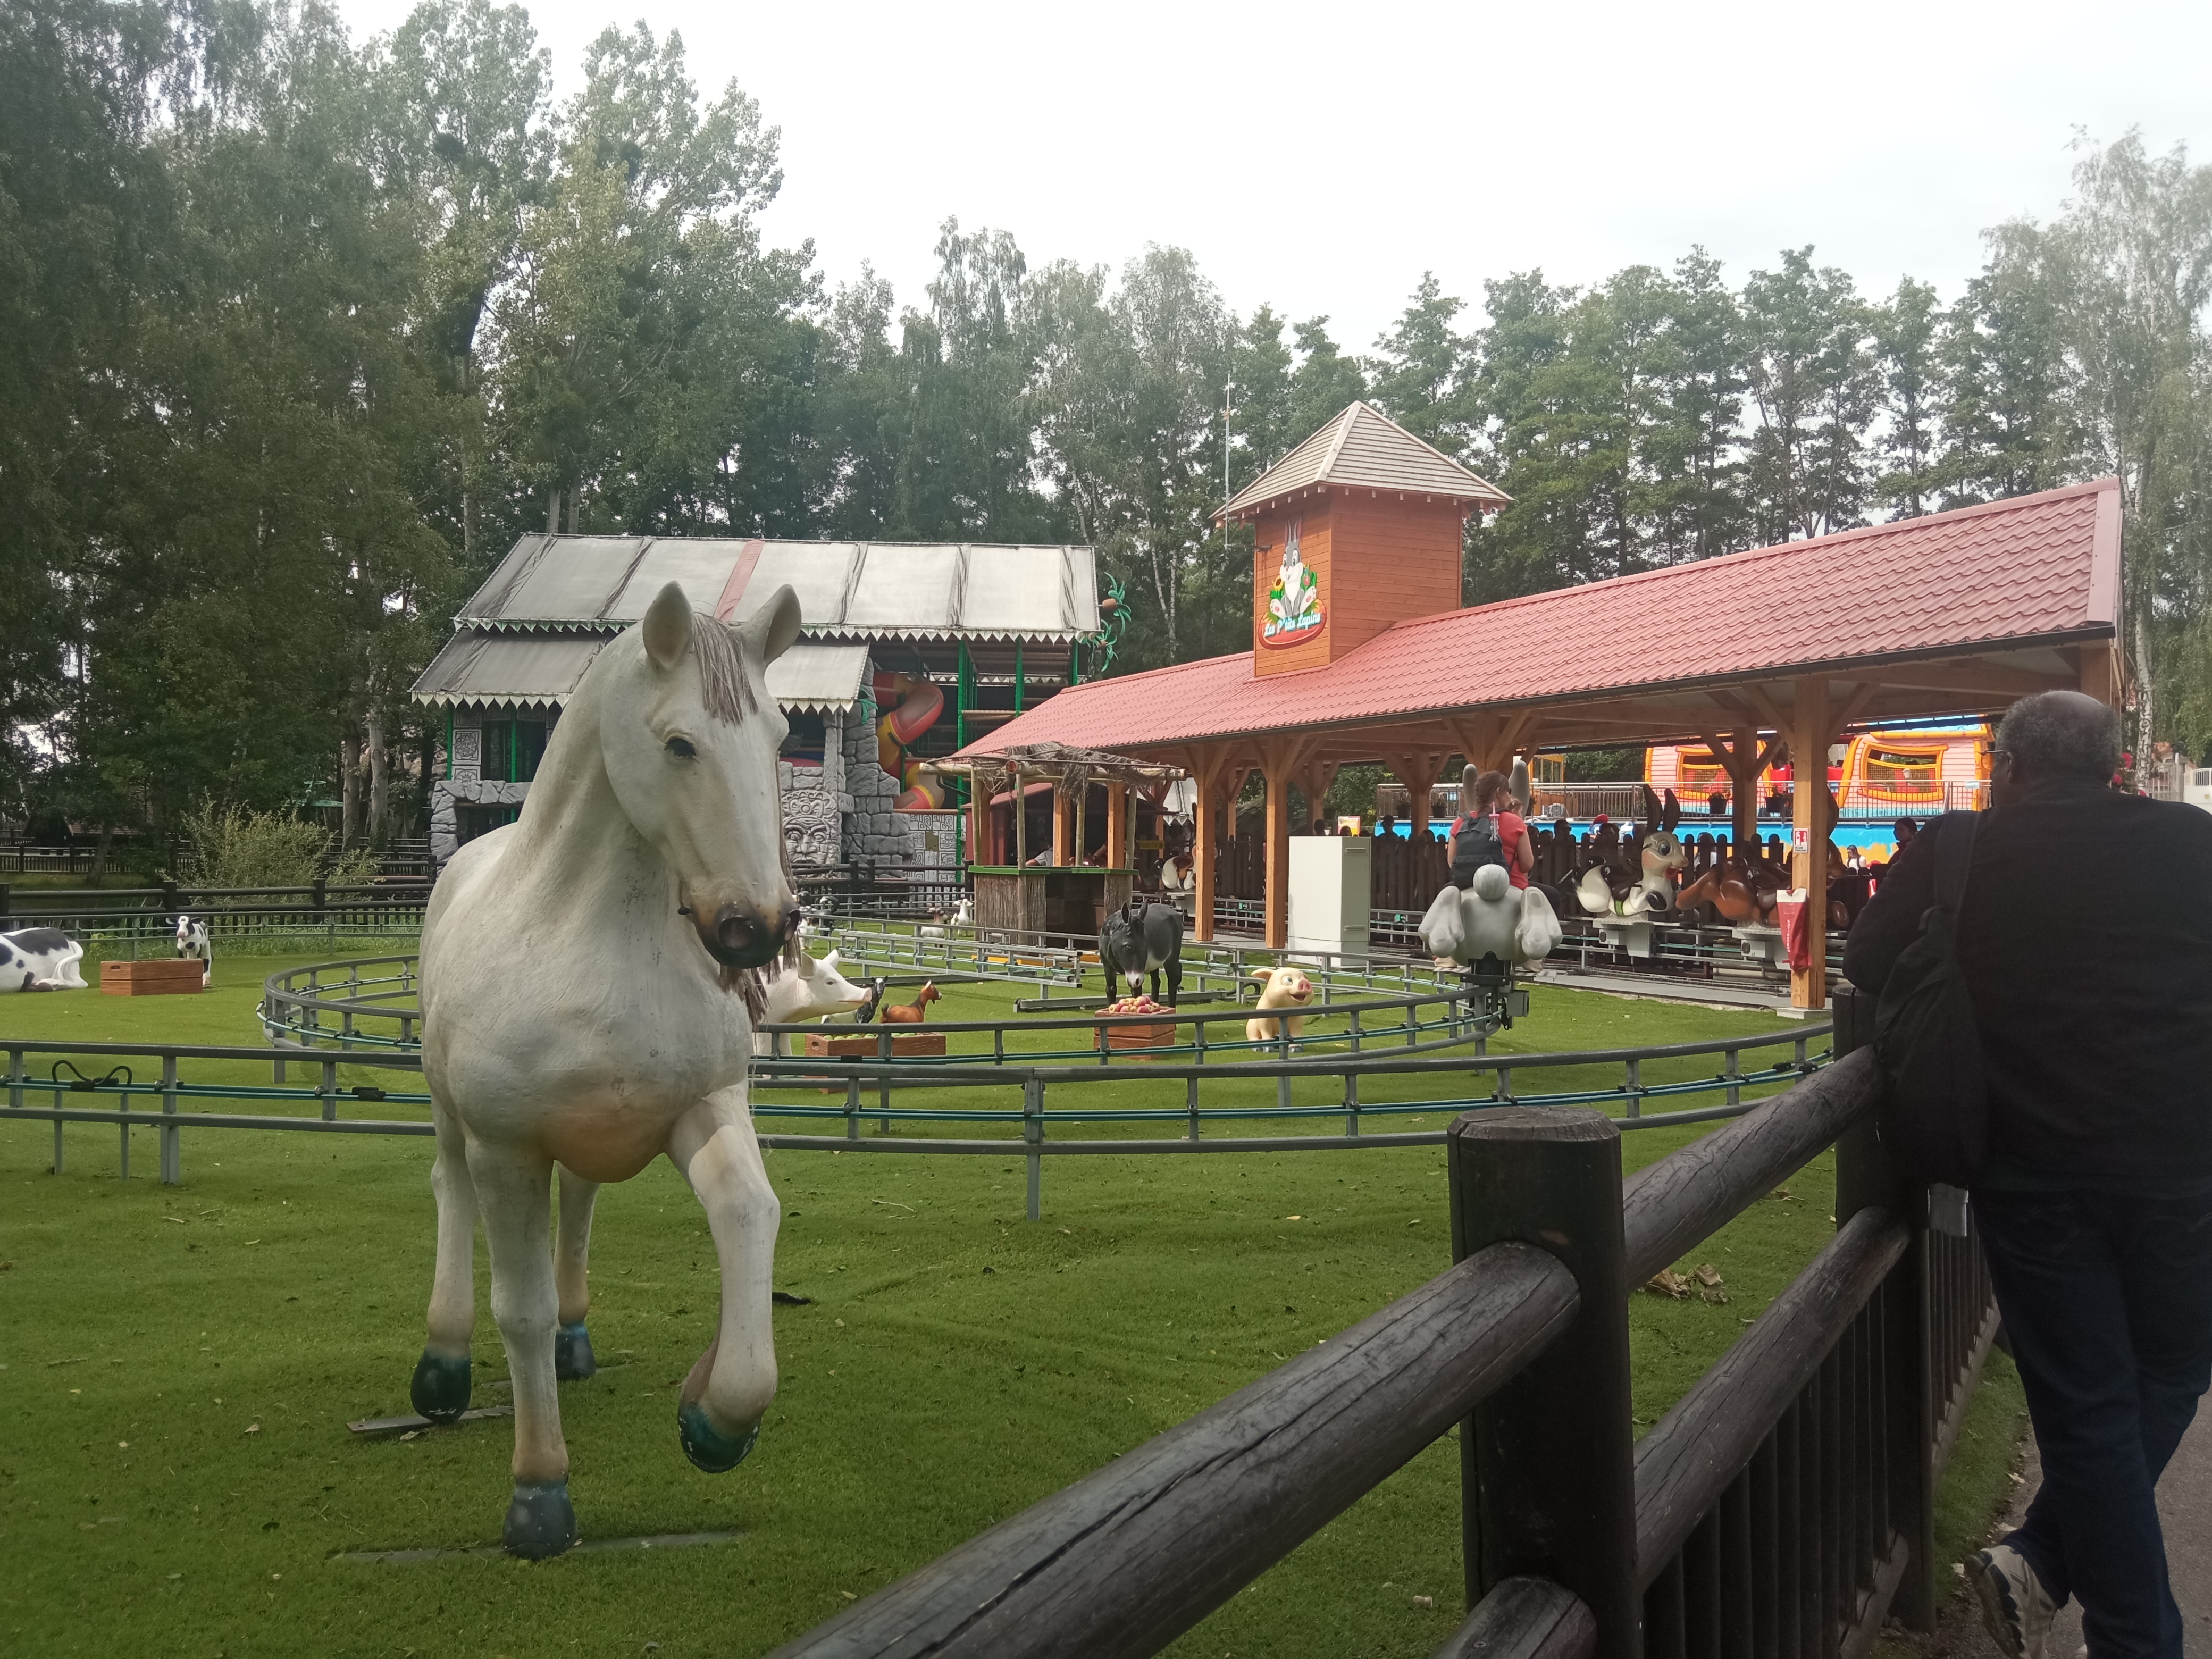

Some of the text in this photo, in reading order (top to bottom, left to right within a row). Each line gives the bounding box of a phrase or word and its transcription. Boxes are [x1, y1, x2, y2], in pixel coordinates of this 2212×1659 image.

[1264, 610, 1321, 637] Les P'tits Lapins
